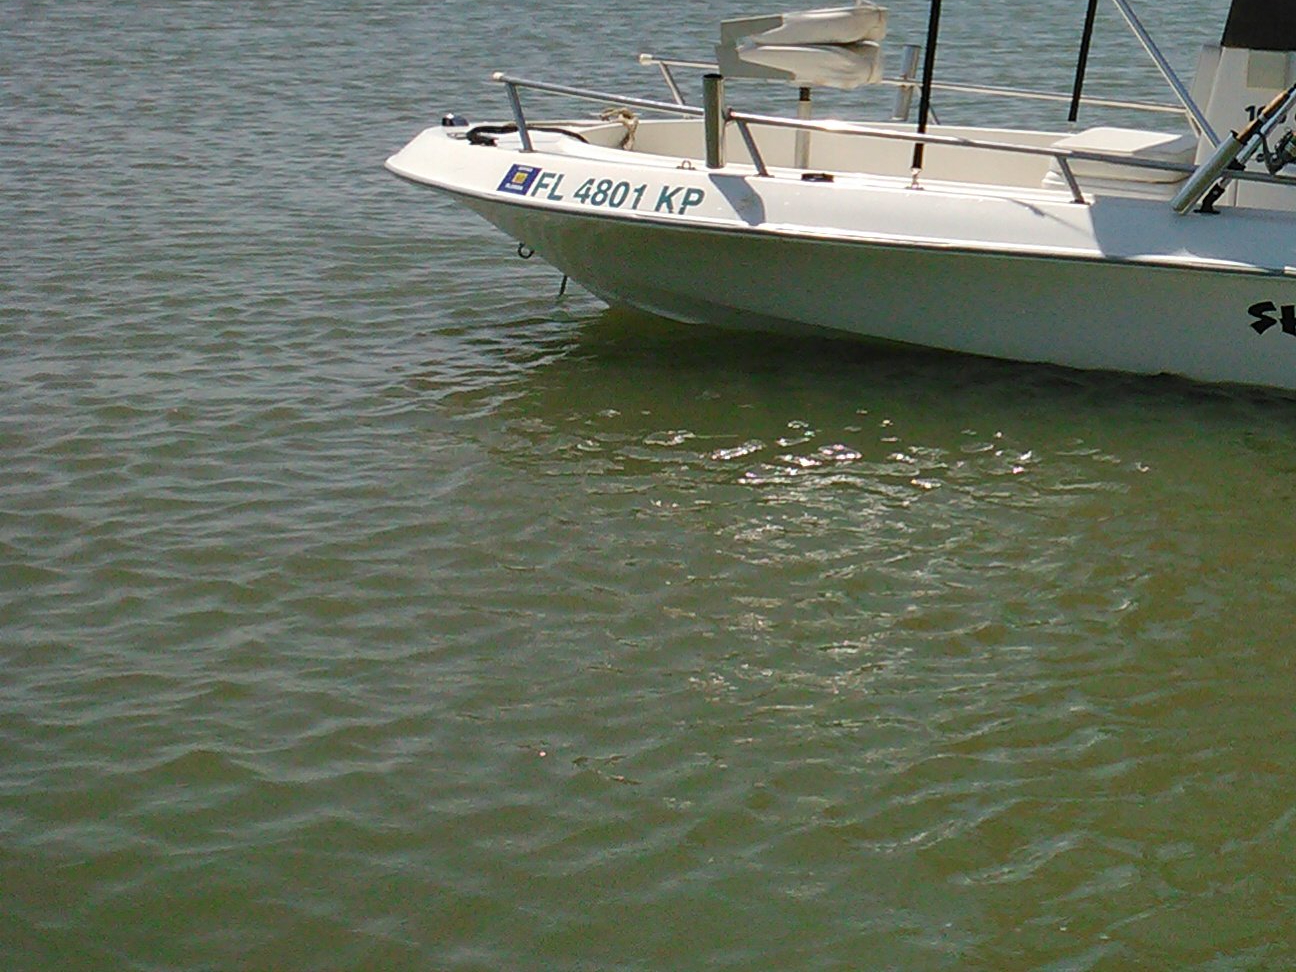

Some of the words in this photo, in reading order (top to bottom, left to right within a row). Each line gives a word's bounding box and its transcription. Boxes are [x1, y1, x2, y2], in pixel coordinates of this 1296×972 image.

[531, 171, 565, 202] FL
[573, 178, 648, 210] 4801
[655, 185, 706, 215] KP
